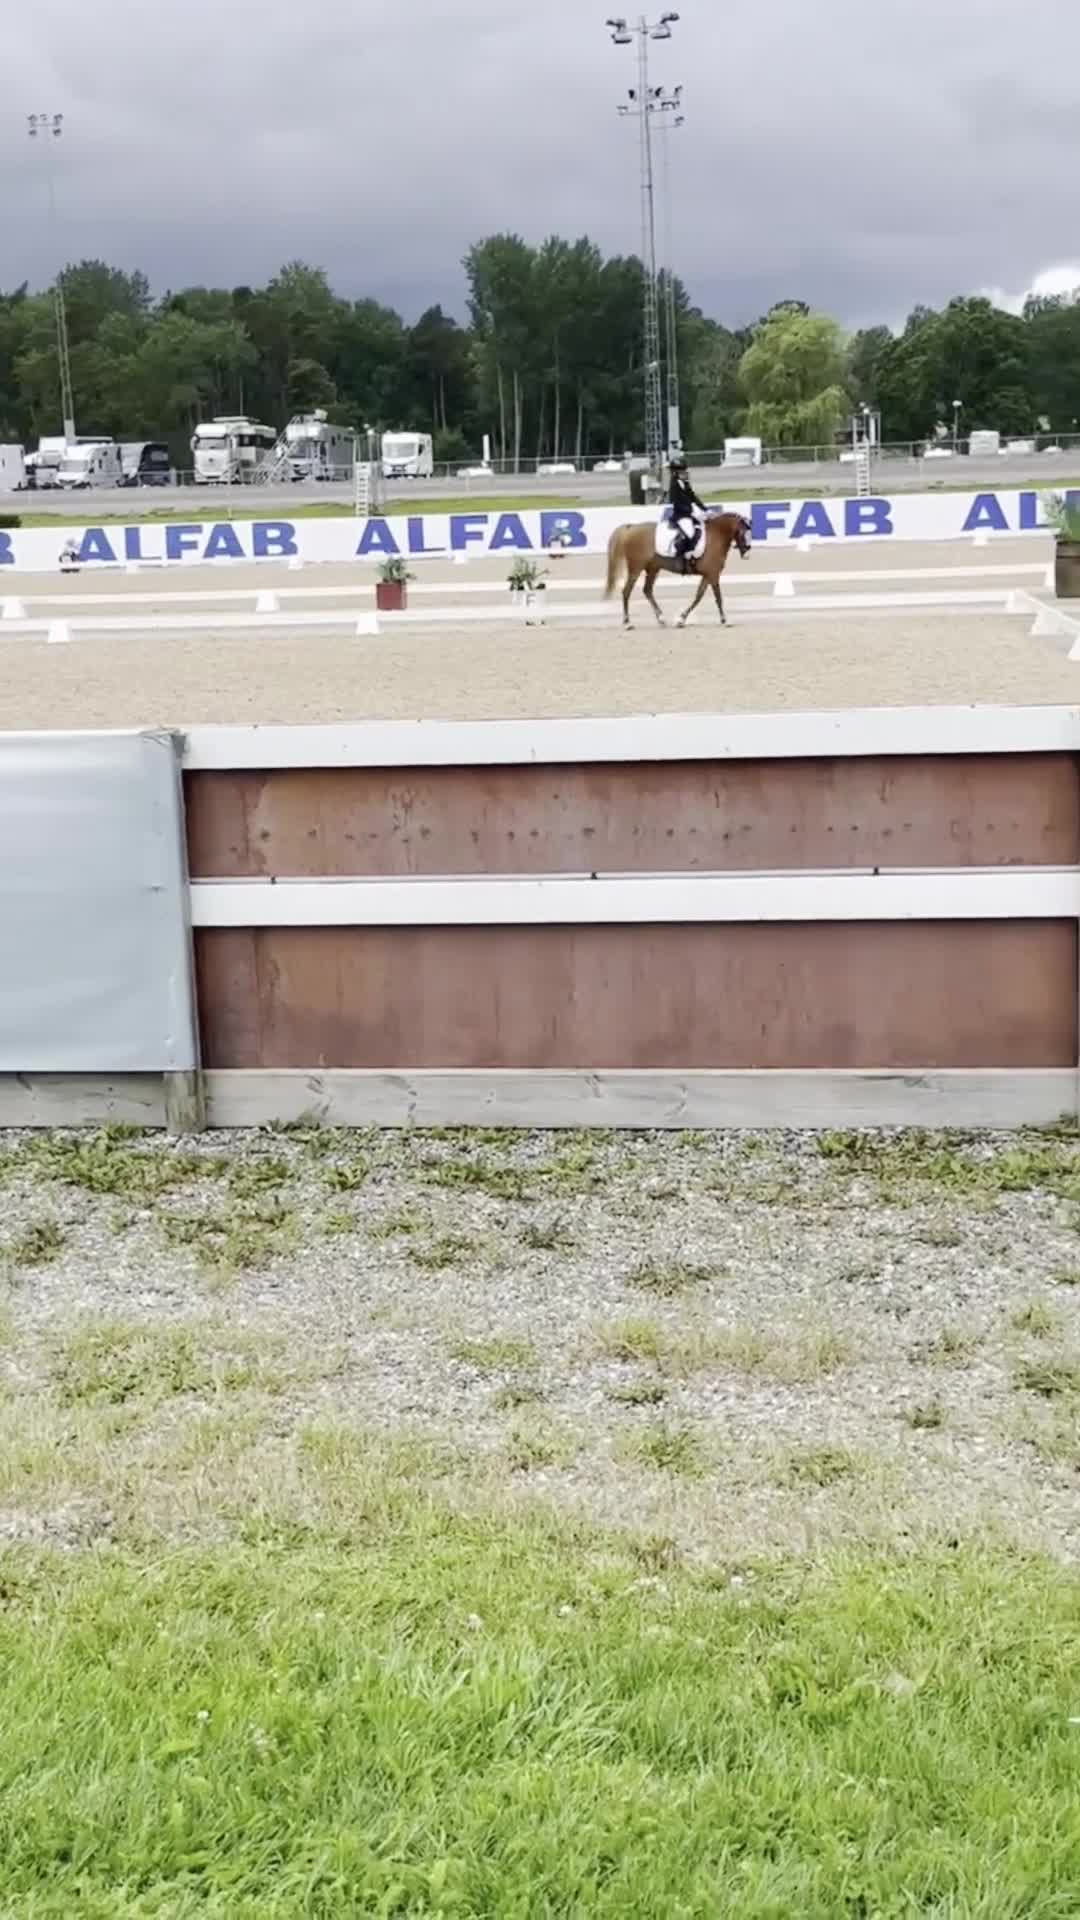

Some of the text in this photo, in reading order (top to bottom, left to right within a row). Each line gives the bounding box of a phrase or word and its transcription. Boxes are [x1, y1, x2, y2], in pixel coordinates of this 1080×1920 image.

[962, 489, 1080, 531] AL
[79, 521, 299, 562] ALFAB
[356, 511, 588, 555] ALFAB
